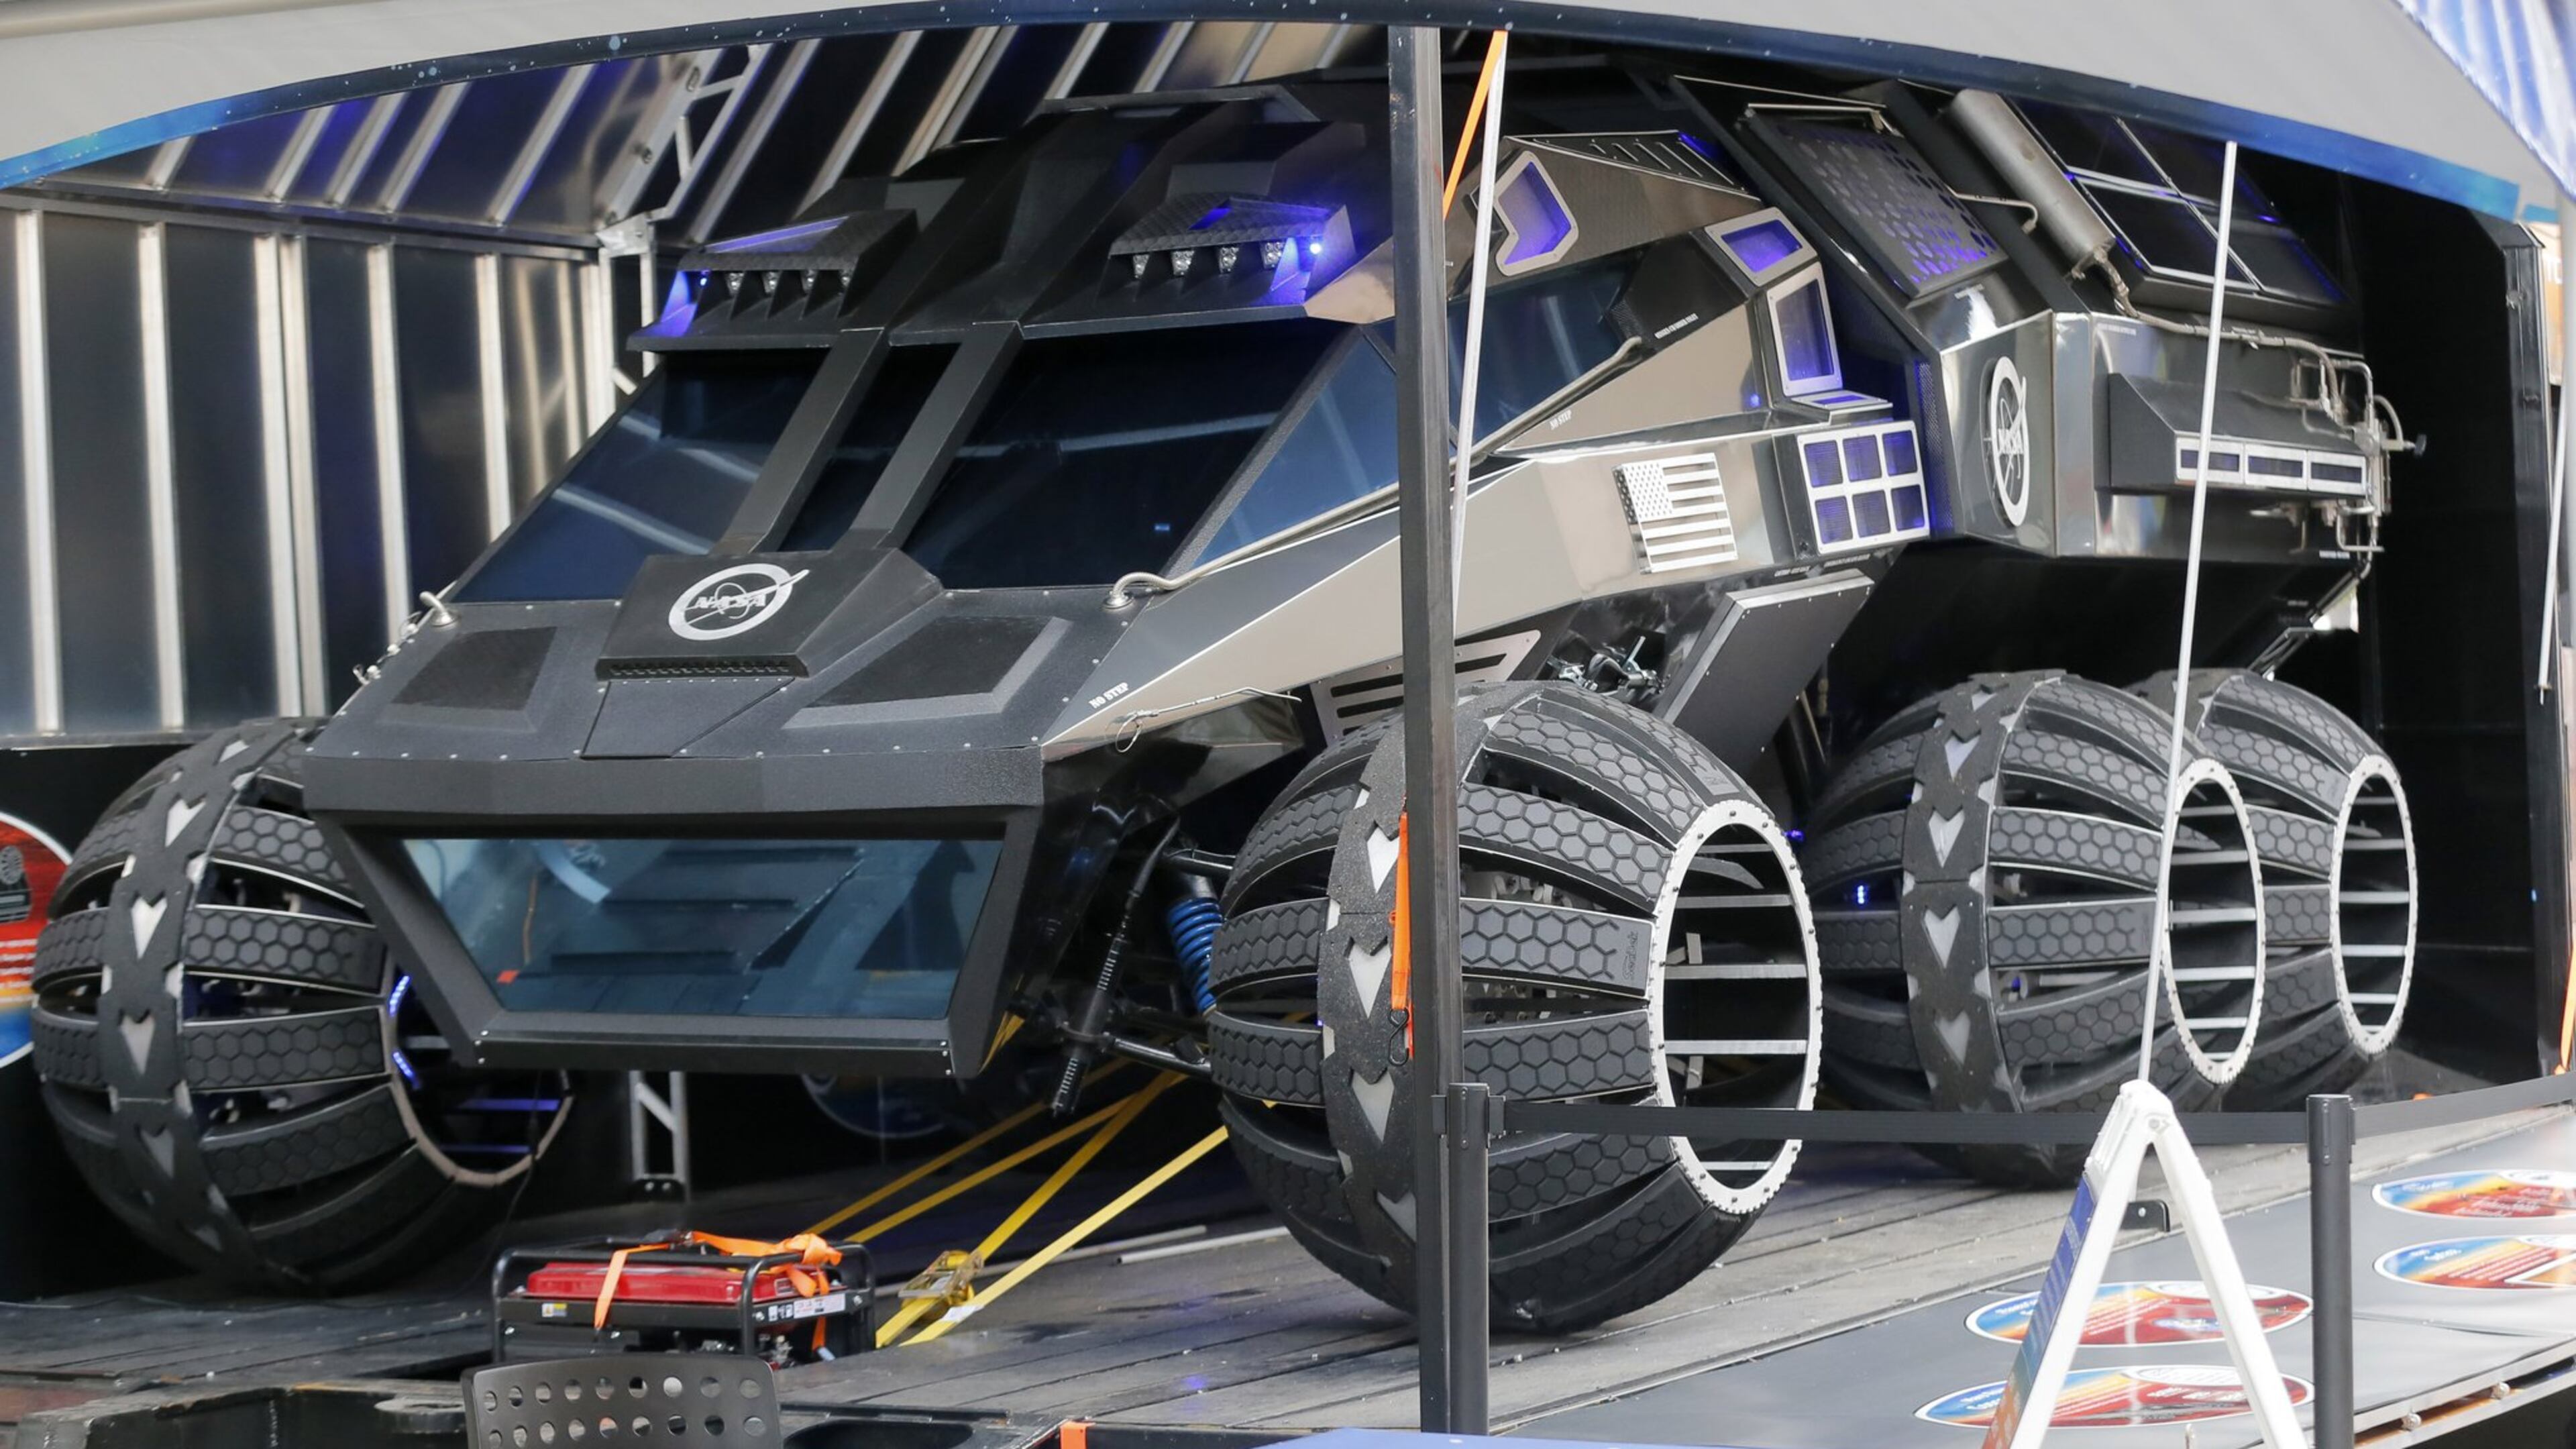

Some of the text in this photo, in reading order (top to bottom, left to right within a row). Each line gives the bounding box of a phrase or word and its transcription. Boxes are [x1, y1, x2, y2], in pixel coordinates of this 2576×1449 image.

[1550, 418, 1559, 430] NO
[1998, 428, 2024, 455] NASA
[694, 594, 766, 609] NASA
[1088, 682, 1128, 709] NO STEP
